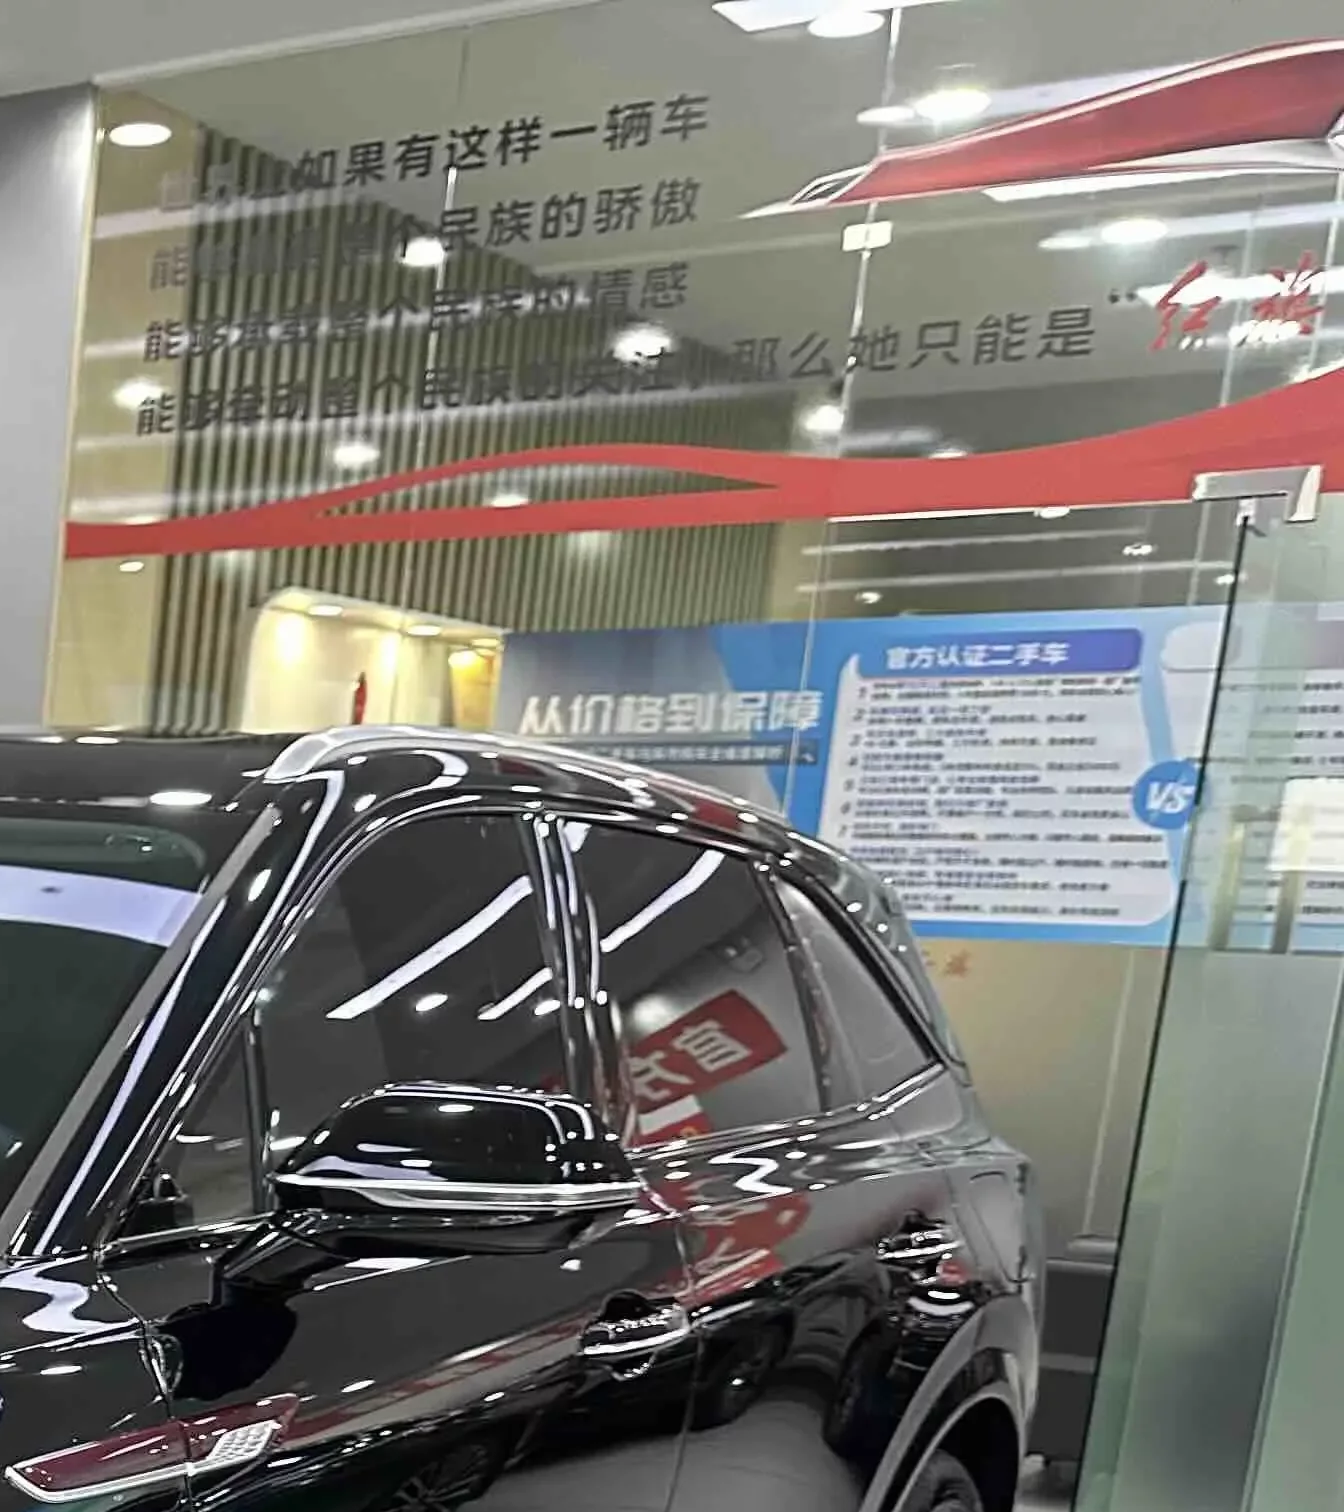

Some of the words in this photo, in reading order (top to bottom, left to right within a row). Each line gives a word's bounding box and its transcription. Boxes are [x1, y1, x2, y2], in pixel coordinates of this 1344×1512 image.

[886, 641, 1072, 670] 官方认证二手车
[518, 690, 825, 737] 从价格到保障
[1145, 781, 1195, 814] VS
